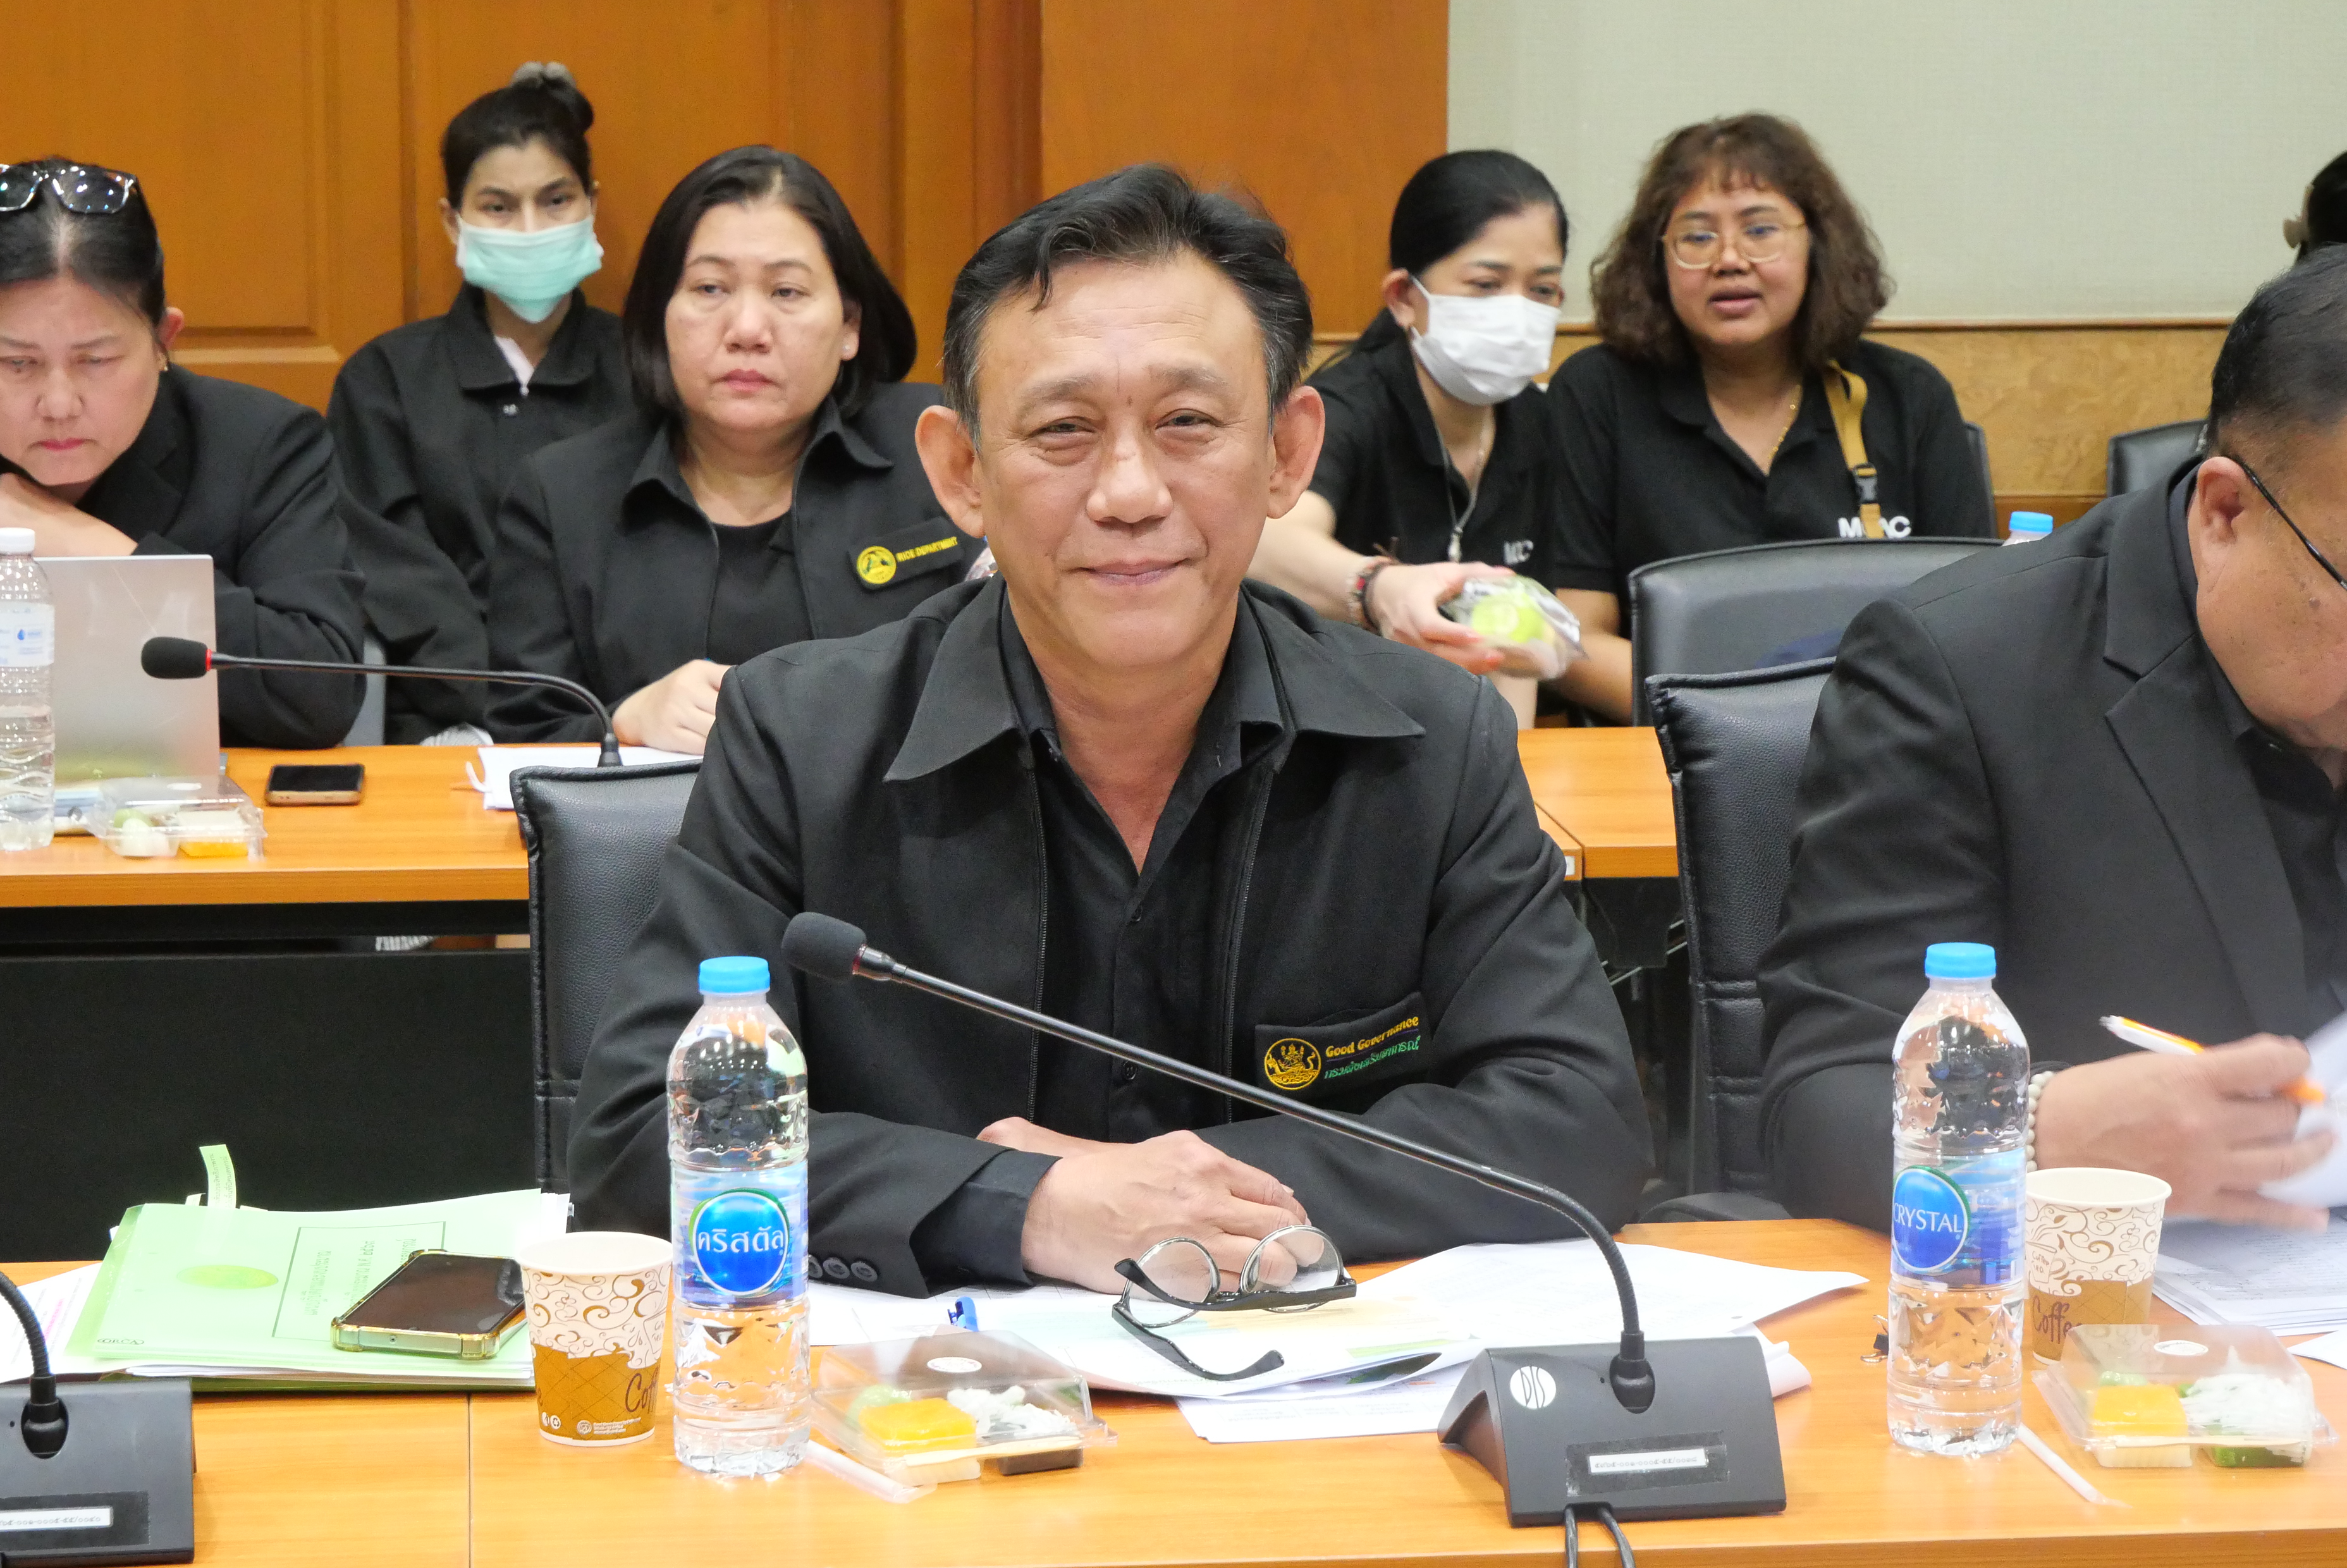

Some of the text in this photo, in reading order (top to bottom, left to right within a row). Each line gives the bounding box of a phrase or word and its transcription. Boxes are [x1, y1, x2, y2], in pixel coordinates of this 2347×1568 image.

[1837, 516, 1911, 538] MC
[1325, 1016, 1419, 1058] Good Governance
[1323, 1034, 1421, 1080] กรมส่งเสริมสหกรณ์
[1894, 1203, 1962, 1233] CRYSTAL
[698, 1226, 783, 1253] คริสตัล
[625, 1366, 659, 1414] Coff
